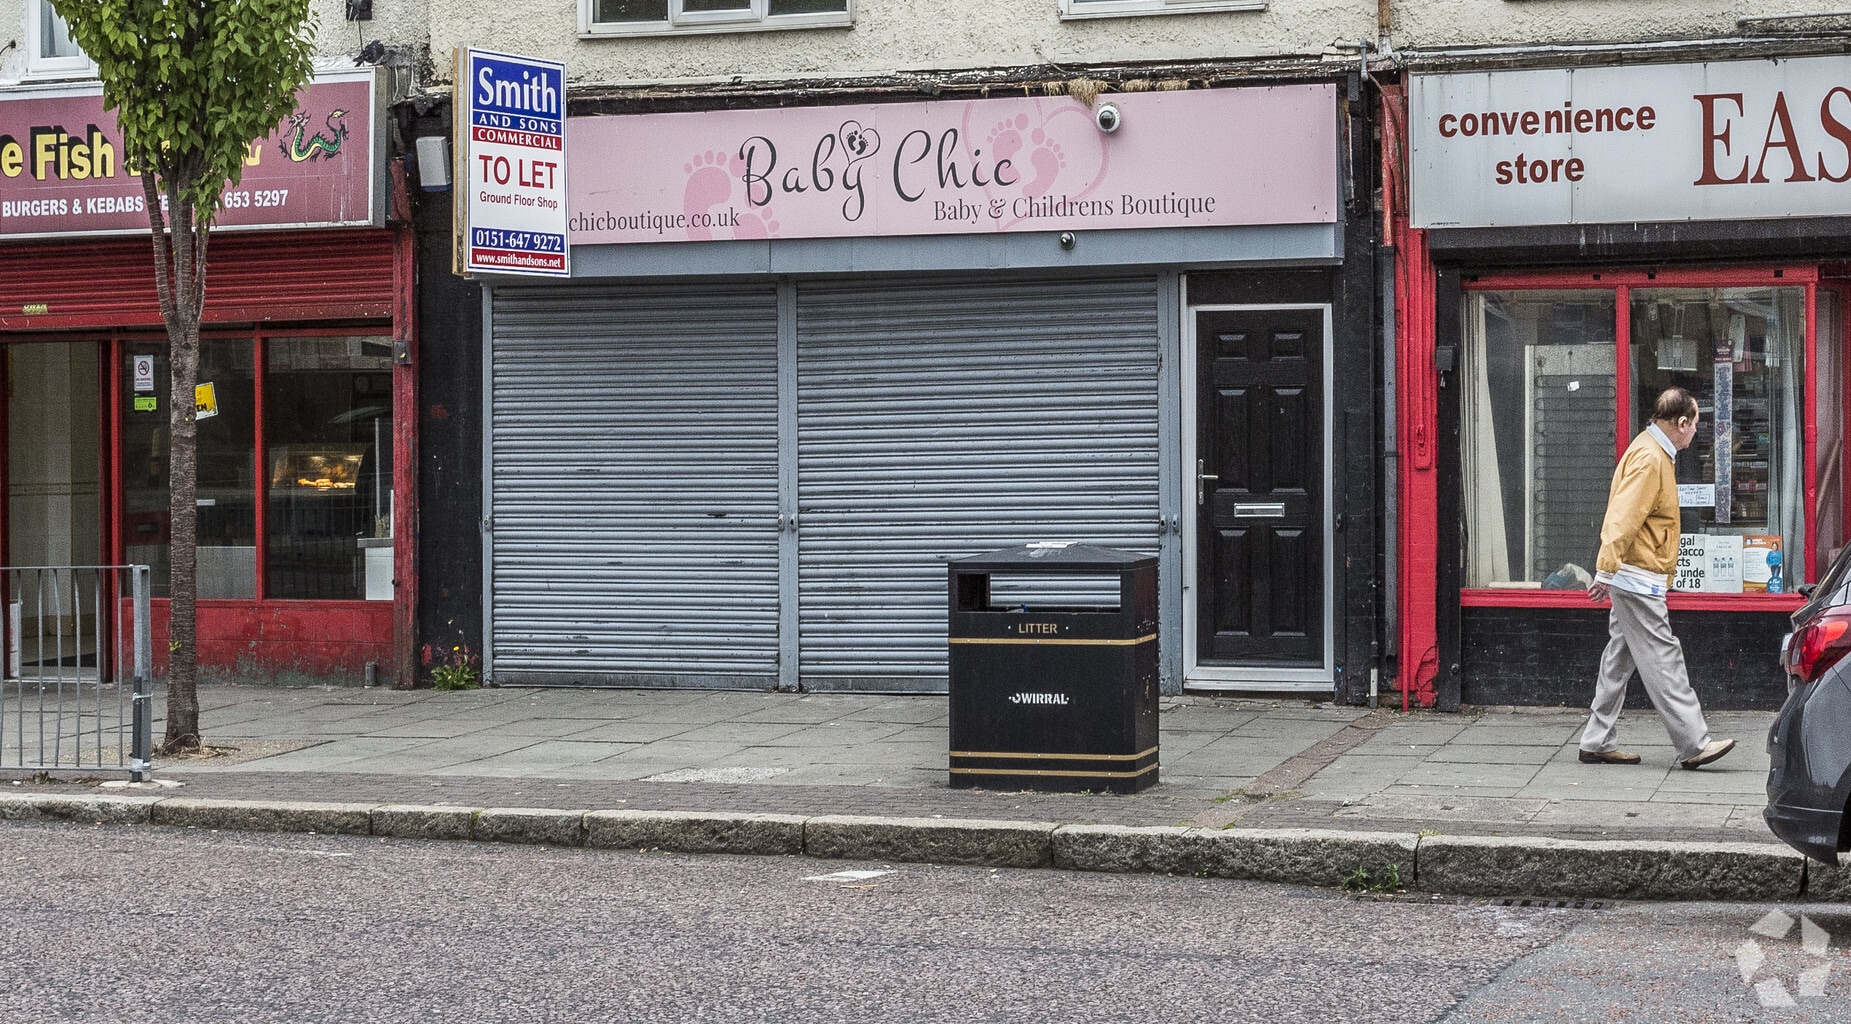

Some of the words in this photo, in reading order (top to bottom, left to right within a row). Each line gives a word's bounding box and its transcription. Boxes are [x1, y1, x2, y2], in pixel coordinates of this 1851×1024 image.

[478, 66, 557, 114] Smith
[479, 114, 511, 127] AND
[519, 118, 557, 133] SONS
[1438, 101, 1656, 138] convenience
[478, 128, 558, 149] COMMERCIAL
[35, 131, 116, 181] Fish
[478, 154, 511, 185] TO
[519, 159, 558, 189] LET
[739, 131, 866, 221] Baby
[893, 127, 1018, 202] Chic
[1495, 153, 1585, 184] store
[2, 198, 68, 217] BURGERS
[72, 198, 83, 214] &
[86, 195, 144, 215] KEBABS
[224, 190, 251, 209] 653
[254, 189, 289, 208] 5297
[479, 191, 512, 205] Ground
[514, 194, 535, 207] Floor
[537, 196, 558, 211] Shop
[933, 198, 982, 224] Baby
[988, 198, 1007, 219] &
[1012, 195, 1114, 218] Childrens
[1121, 191, 1216, 218] Boutique
[568, 207, 741, 234] chicboutique.co.uk
[476, 229, 530, 249] 0151-647
[533, 234, 561, 251] 9272
[476, 253, 562, 268] www.smithandsons.net
[1676, 578, 1687, 588] of
[1688, 578, 1701, 589] 18
[1018, 623, 1058, 634] LITTER
[1021, 693, 1068, 705] WIRRAL
